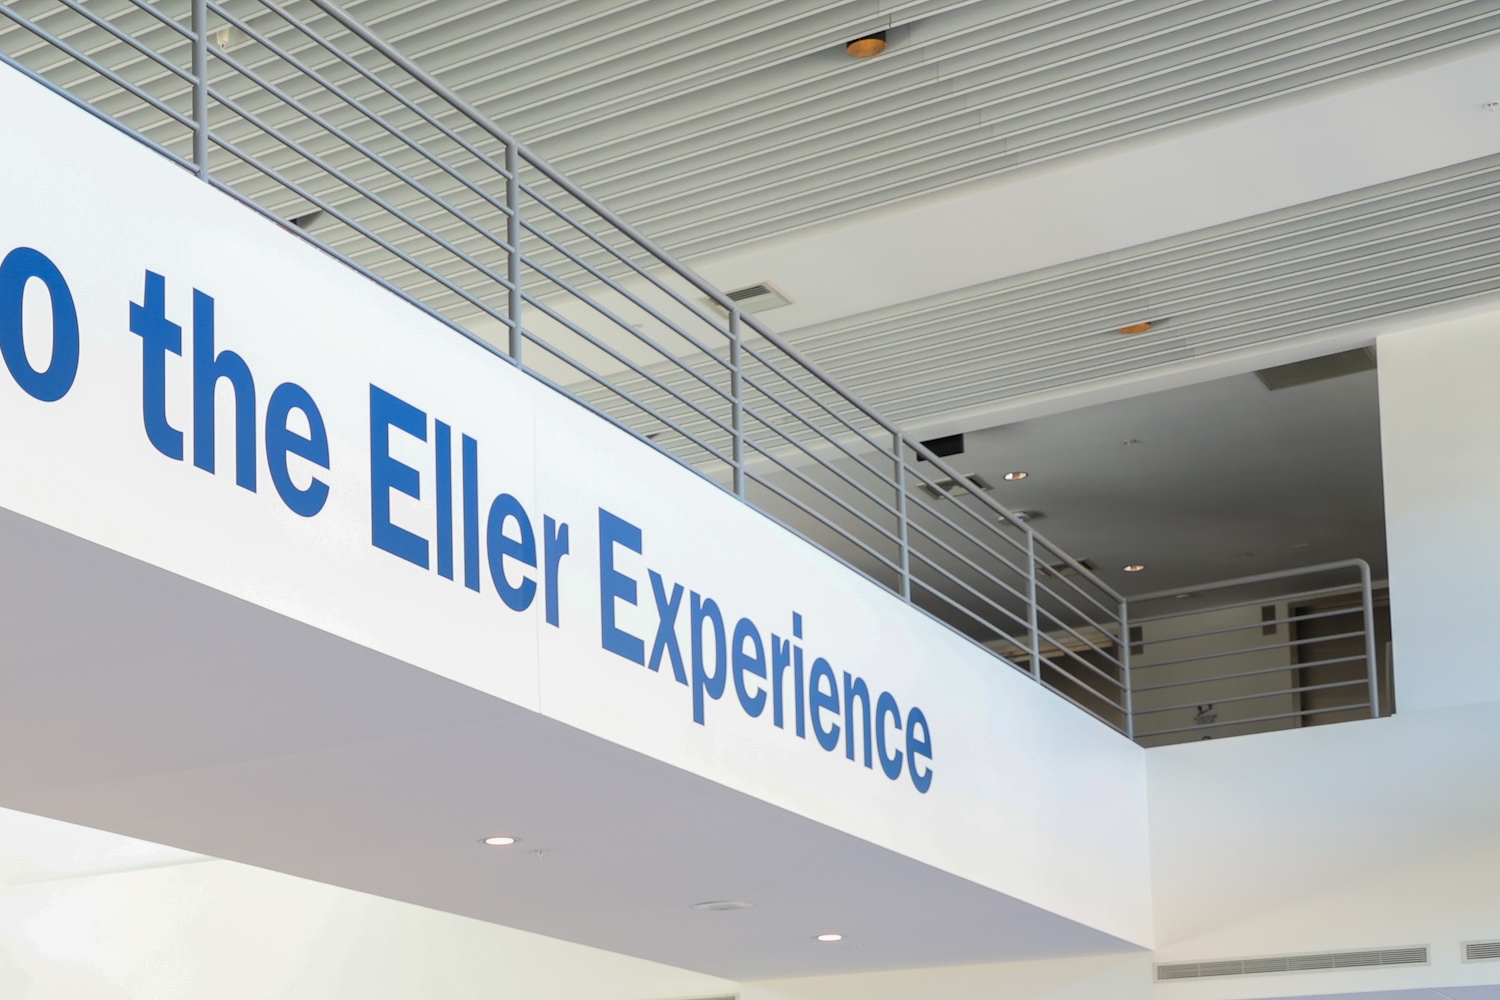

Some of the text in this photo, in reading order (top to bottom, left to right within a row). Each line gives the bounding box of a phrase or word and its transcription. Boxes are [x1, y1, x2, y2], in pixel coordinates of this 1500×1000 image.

[129, 268, 330, 518] the
[369, 382, 570, 628] Eller
[598, 506, 933, 795] Experience
